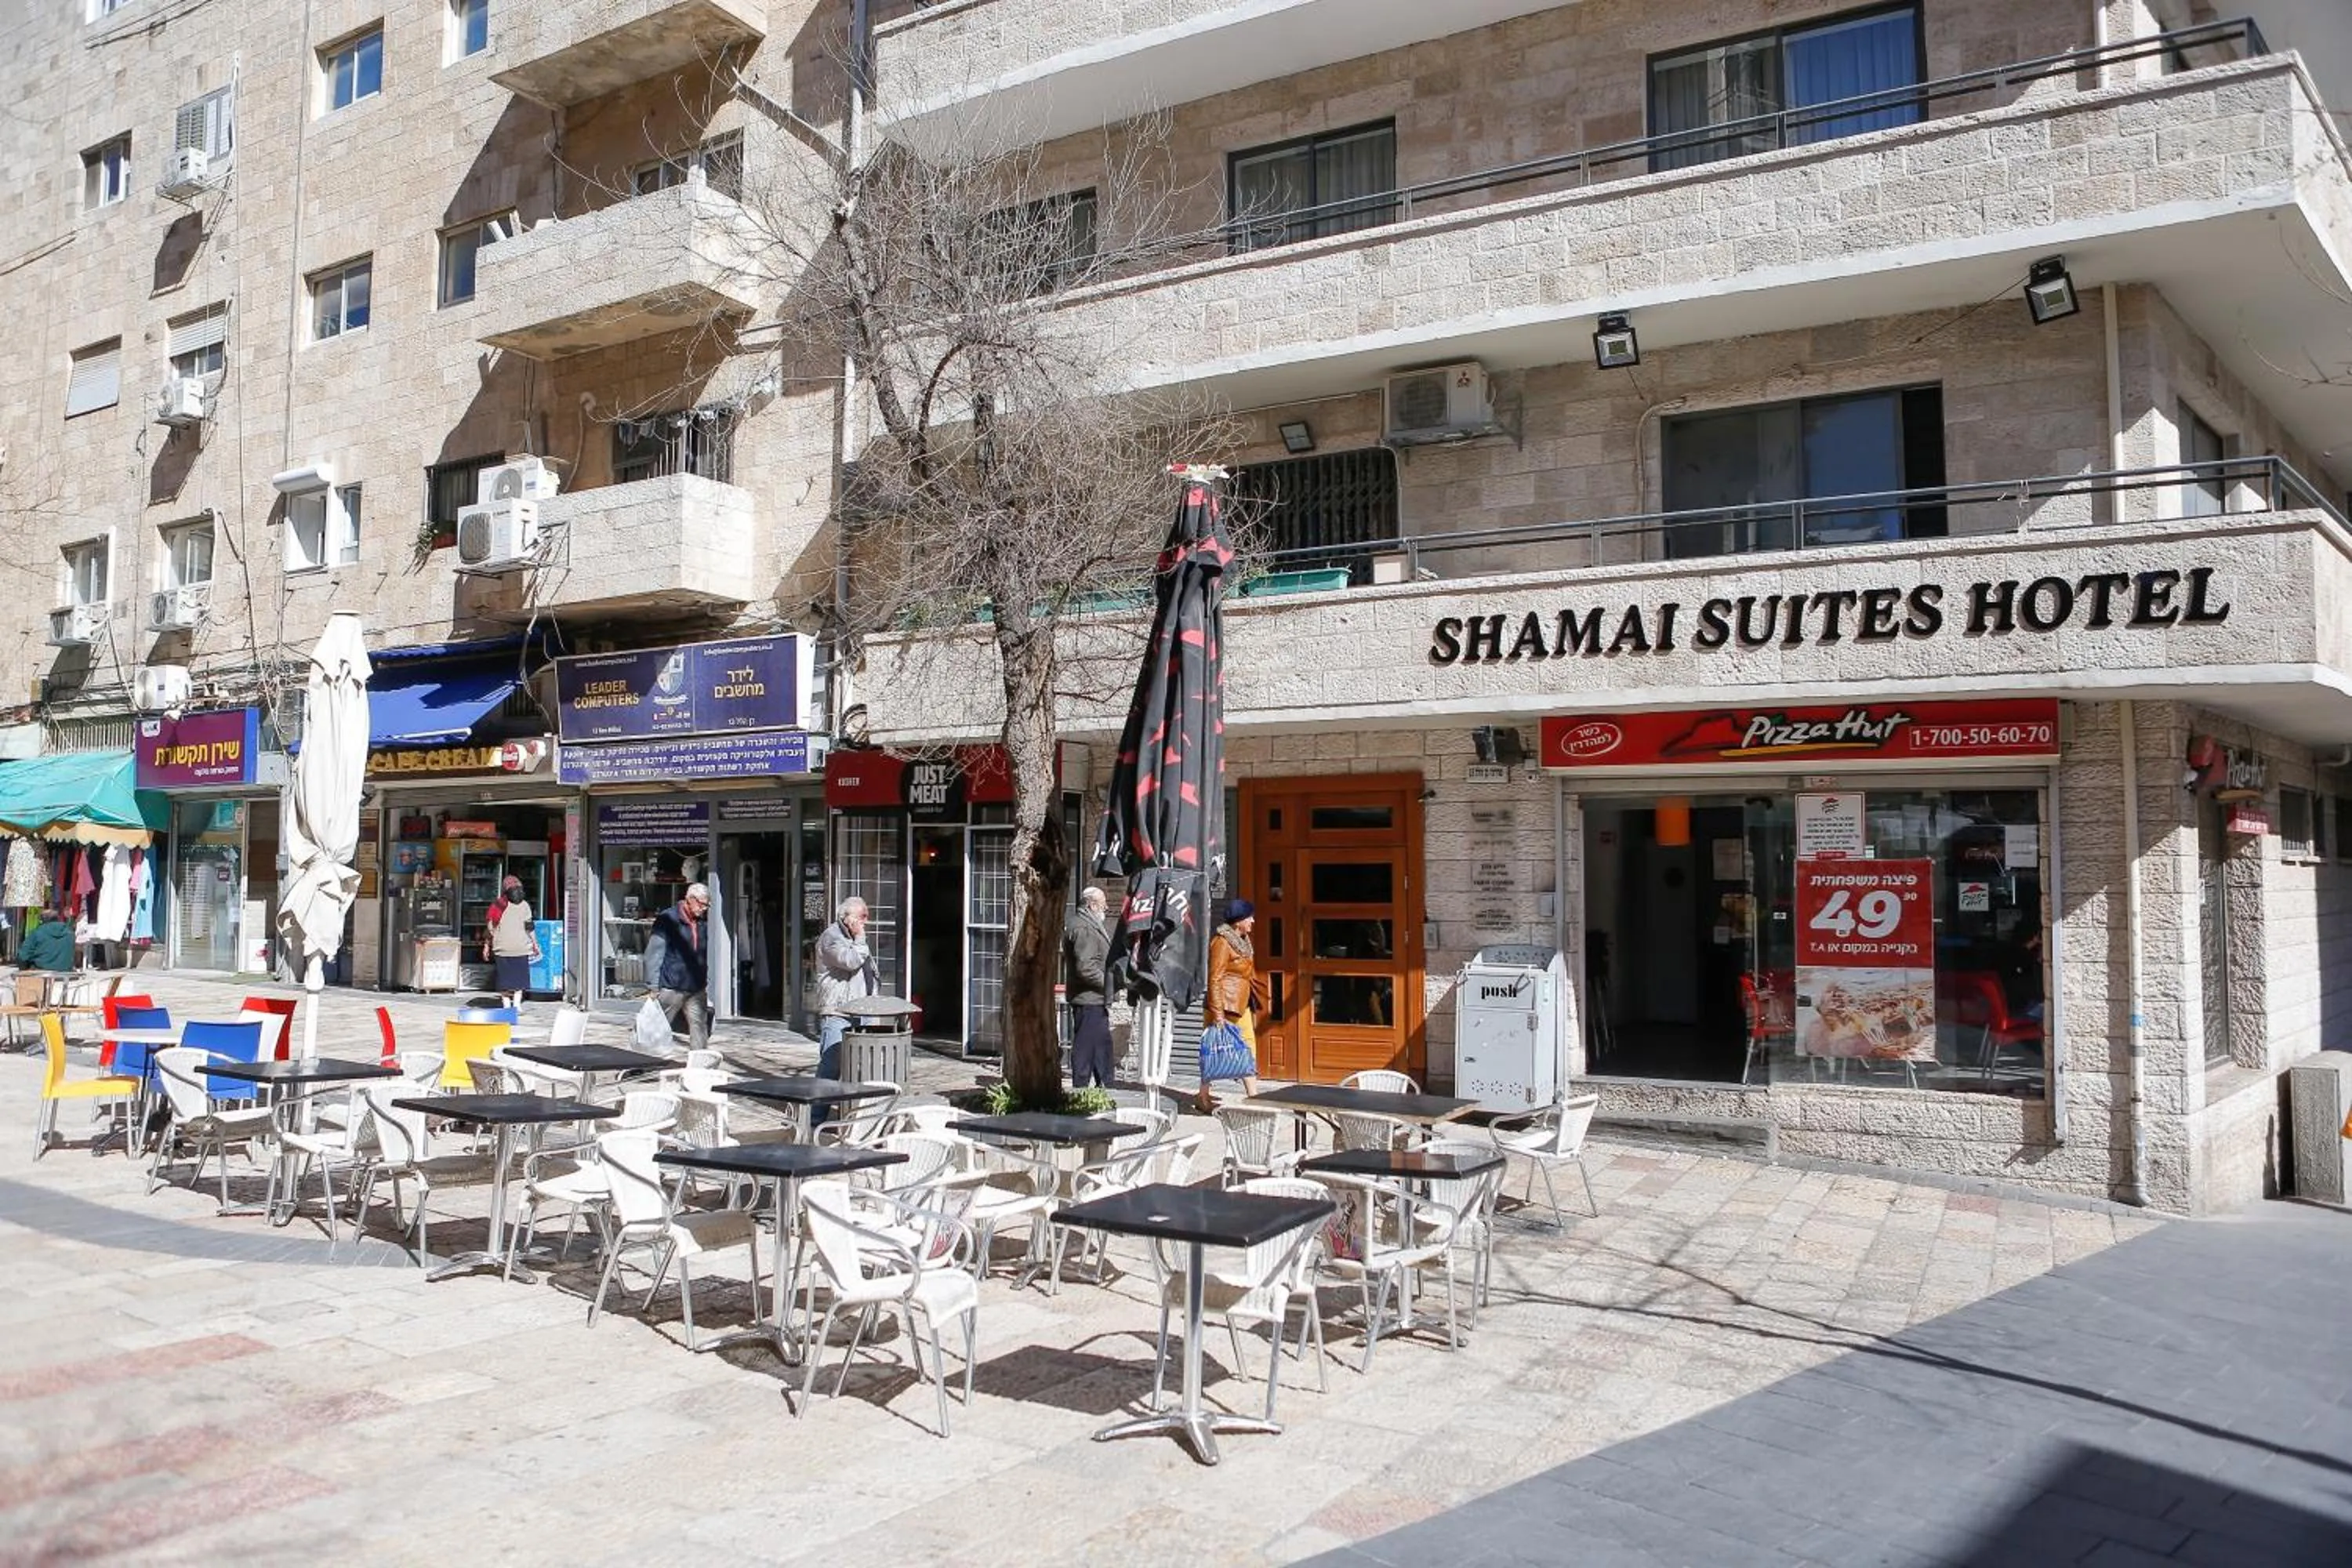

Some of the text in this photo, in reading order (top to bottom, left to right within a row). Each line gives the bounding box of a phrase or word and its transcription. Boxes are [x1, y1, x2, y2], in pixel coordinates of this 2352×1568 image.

[1428, 567, 2230, 668] SHAMAI SUITES HOTEL
[728, 665, 753, 683] לידר
[584, 680, 626, 695] LEADER
[714, 683, 764, 699] מחשבים
[574, 692, 640, 710] COMPUTERS
[1577, 726, 1600, 738] כשר
[1741, 710, 1911, 748] Pizza Hut
[1911, 726, 2051, 746] 1-700-50-60-70
[1570, 733, 1612, 752] למהדרין
[154, 740, 240, 768] שירן תקשורת
[370, 750, 426, 772] CAFE
[912, 764, 946, 785] JUST
[909, 785, 948, 804] MEAT
[1809, 874, 1918, 887] פיצה משפחתית
[1809, 890, 1903, 938] 49
[1828, 943, 1839, 953] או
[1842, 943, 1878, 954] במקום
[1882, 943, 1918, 956] בקנייה
[1481, 984, 1517, 1000] push
